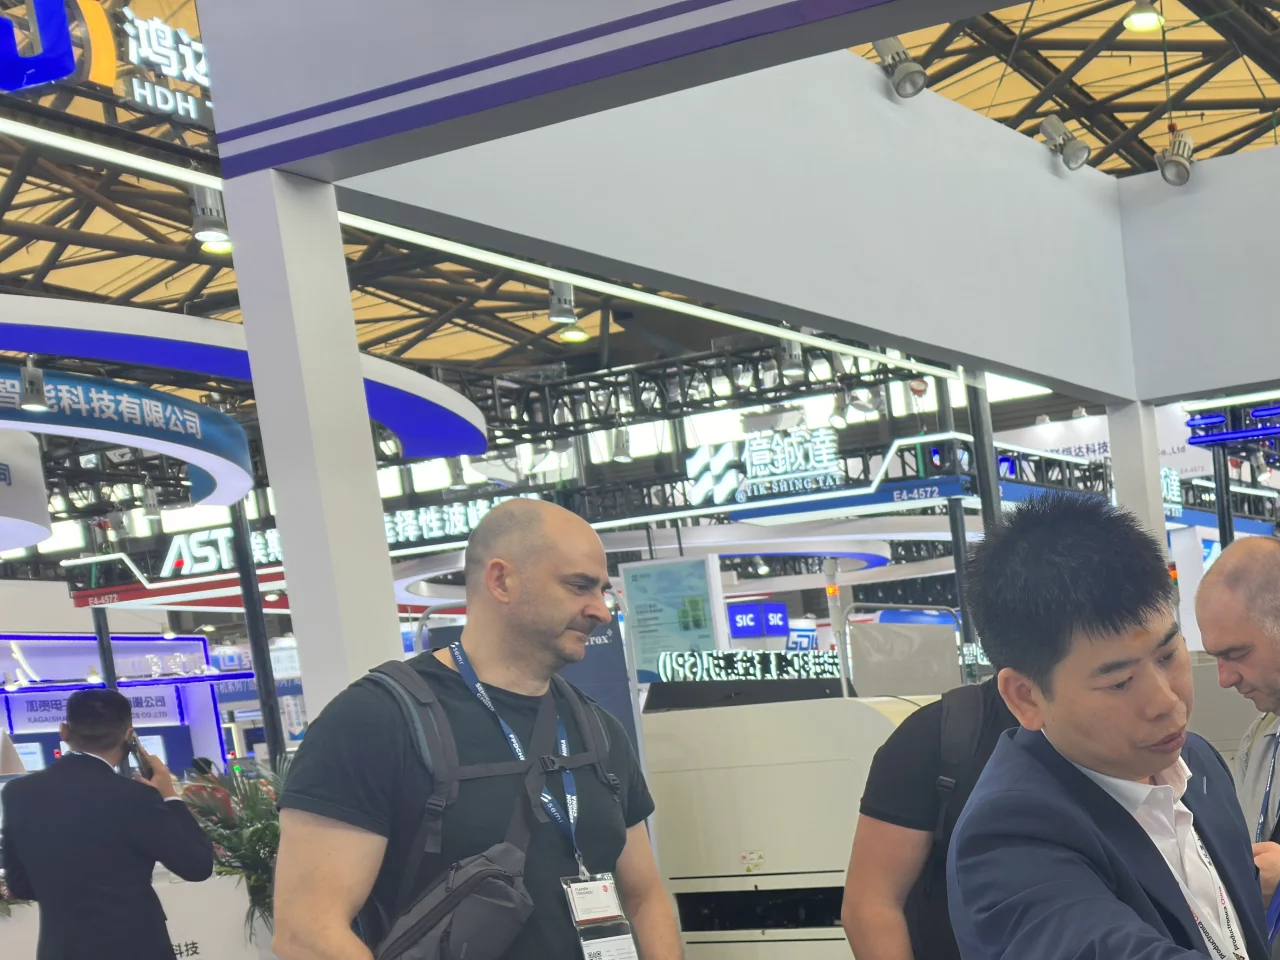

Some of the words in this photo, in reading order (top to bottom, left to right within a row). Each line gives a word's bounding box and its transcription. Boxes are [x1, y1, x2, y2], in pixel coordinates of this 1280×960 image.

[132, 78, 199, 120] HDH
[893, 486, 940, 502] E4-4572
[160, 527, 237, 579] AST
[735, 613, 755, 628] SIC
[768, 612, 784, 626] SIC
[1197, 920, 1227, 960] productronica
